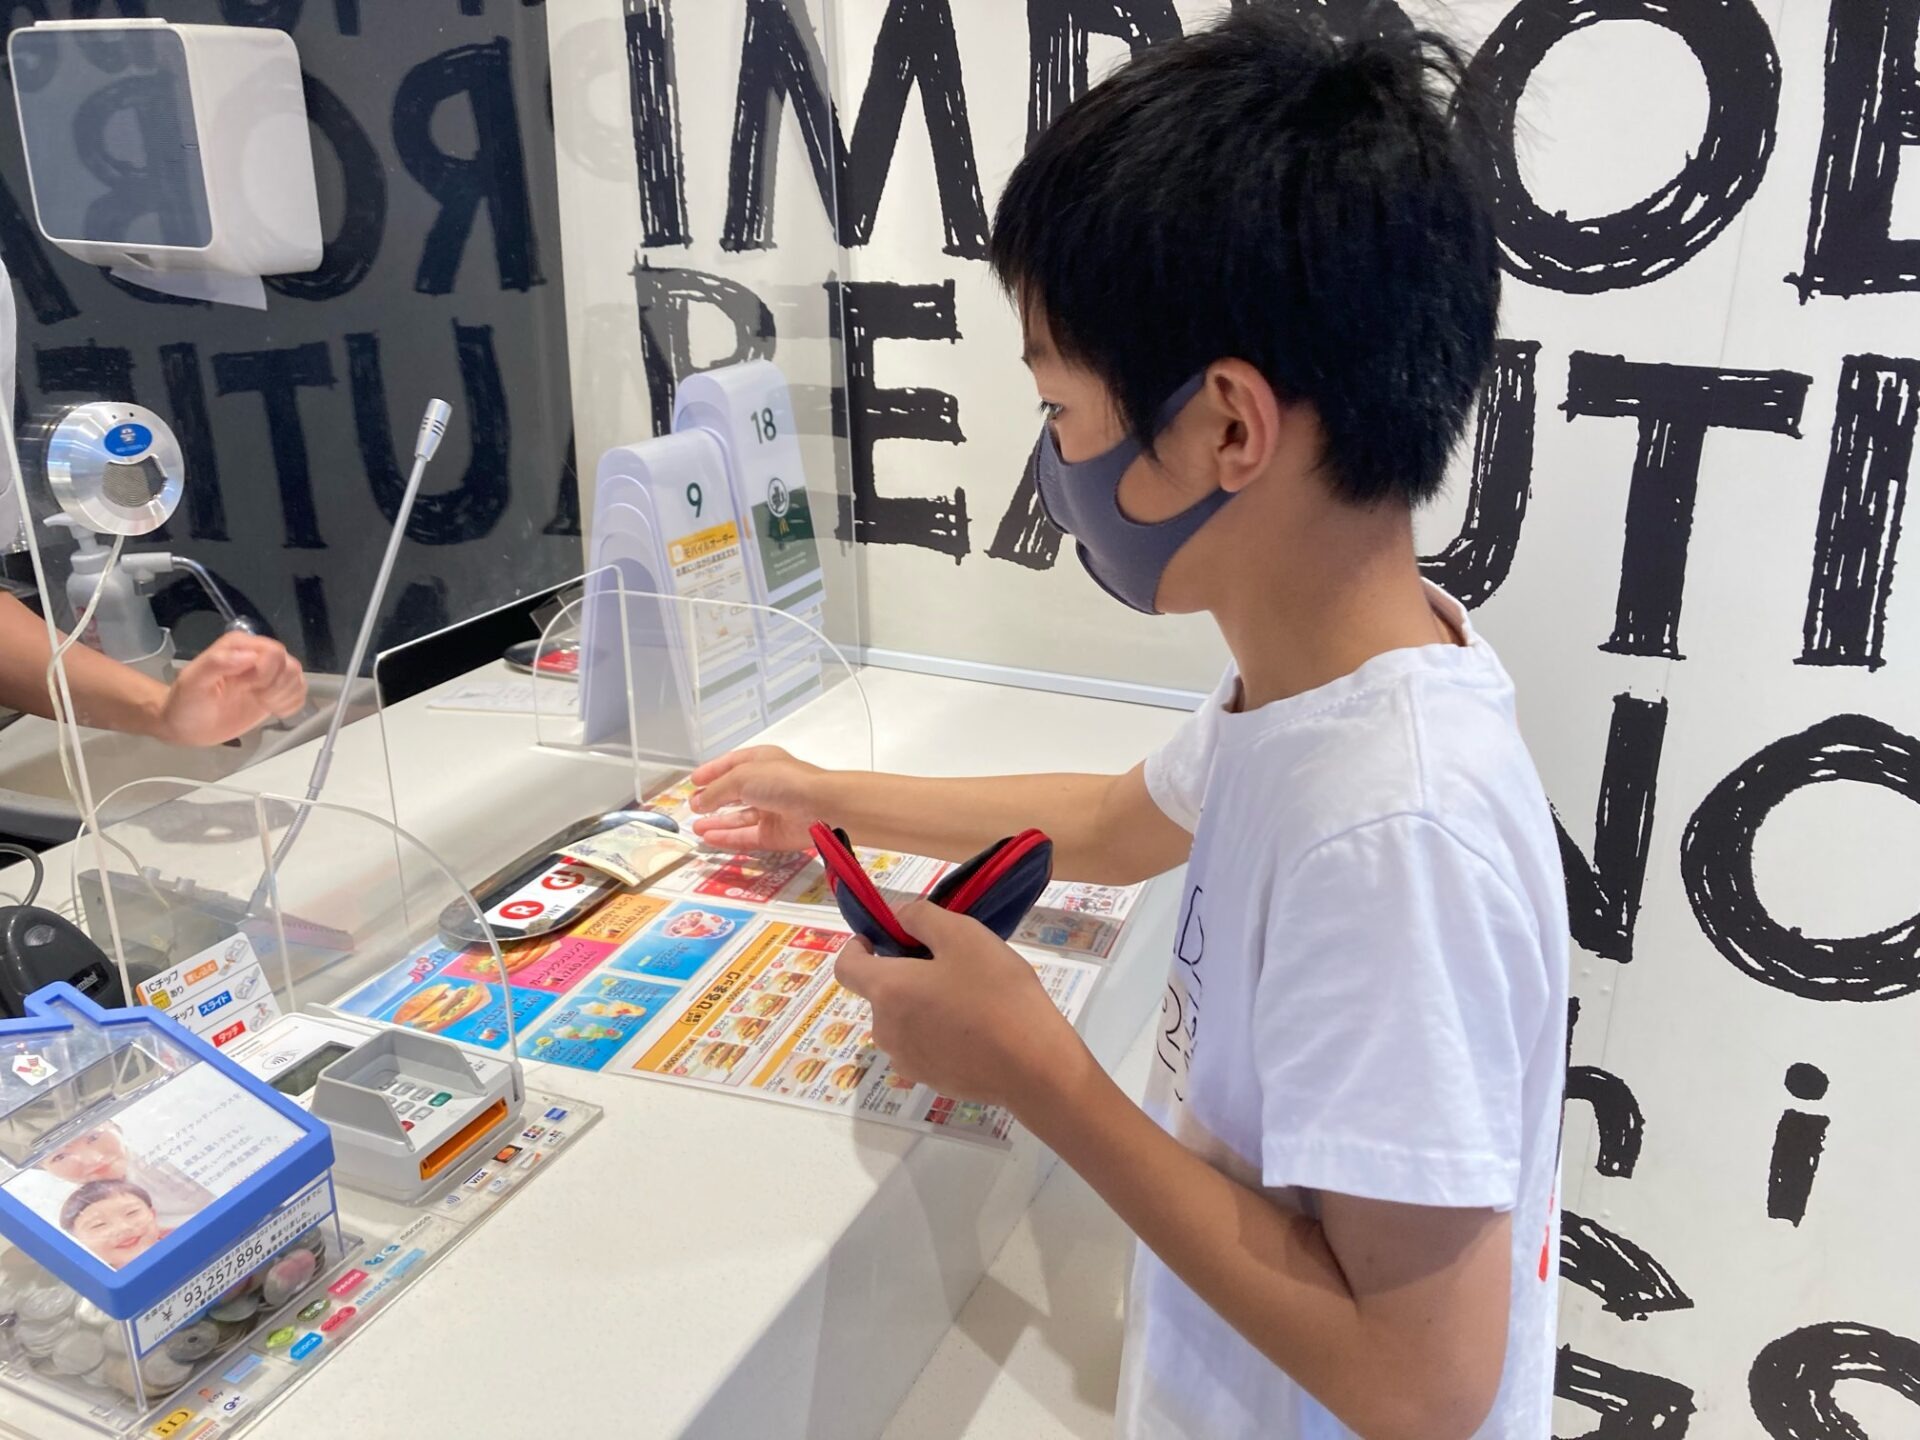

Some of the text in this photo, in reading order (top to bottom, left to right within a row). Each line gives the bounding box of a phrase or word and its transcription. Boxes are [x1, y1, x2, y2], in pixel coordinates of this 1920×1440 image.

[750, 407, 777, 445] 18
[686, 482, 703, 518] 9
[145, 971, 178, 994] ICチップ
[170, 986, 184, 998] あり
[201, 993, 229, 1016] スライド
[217, 1025, 240, 1043] タッチ
[471, 1171, 489, 1185] VISA
[184, 1240, 264, 1307] 93,257,896
[157, 1411, 189, 1434] iD
